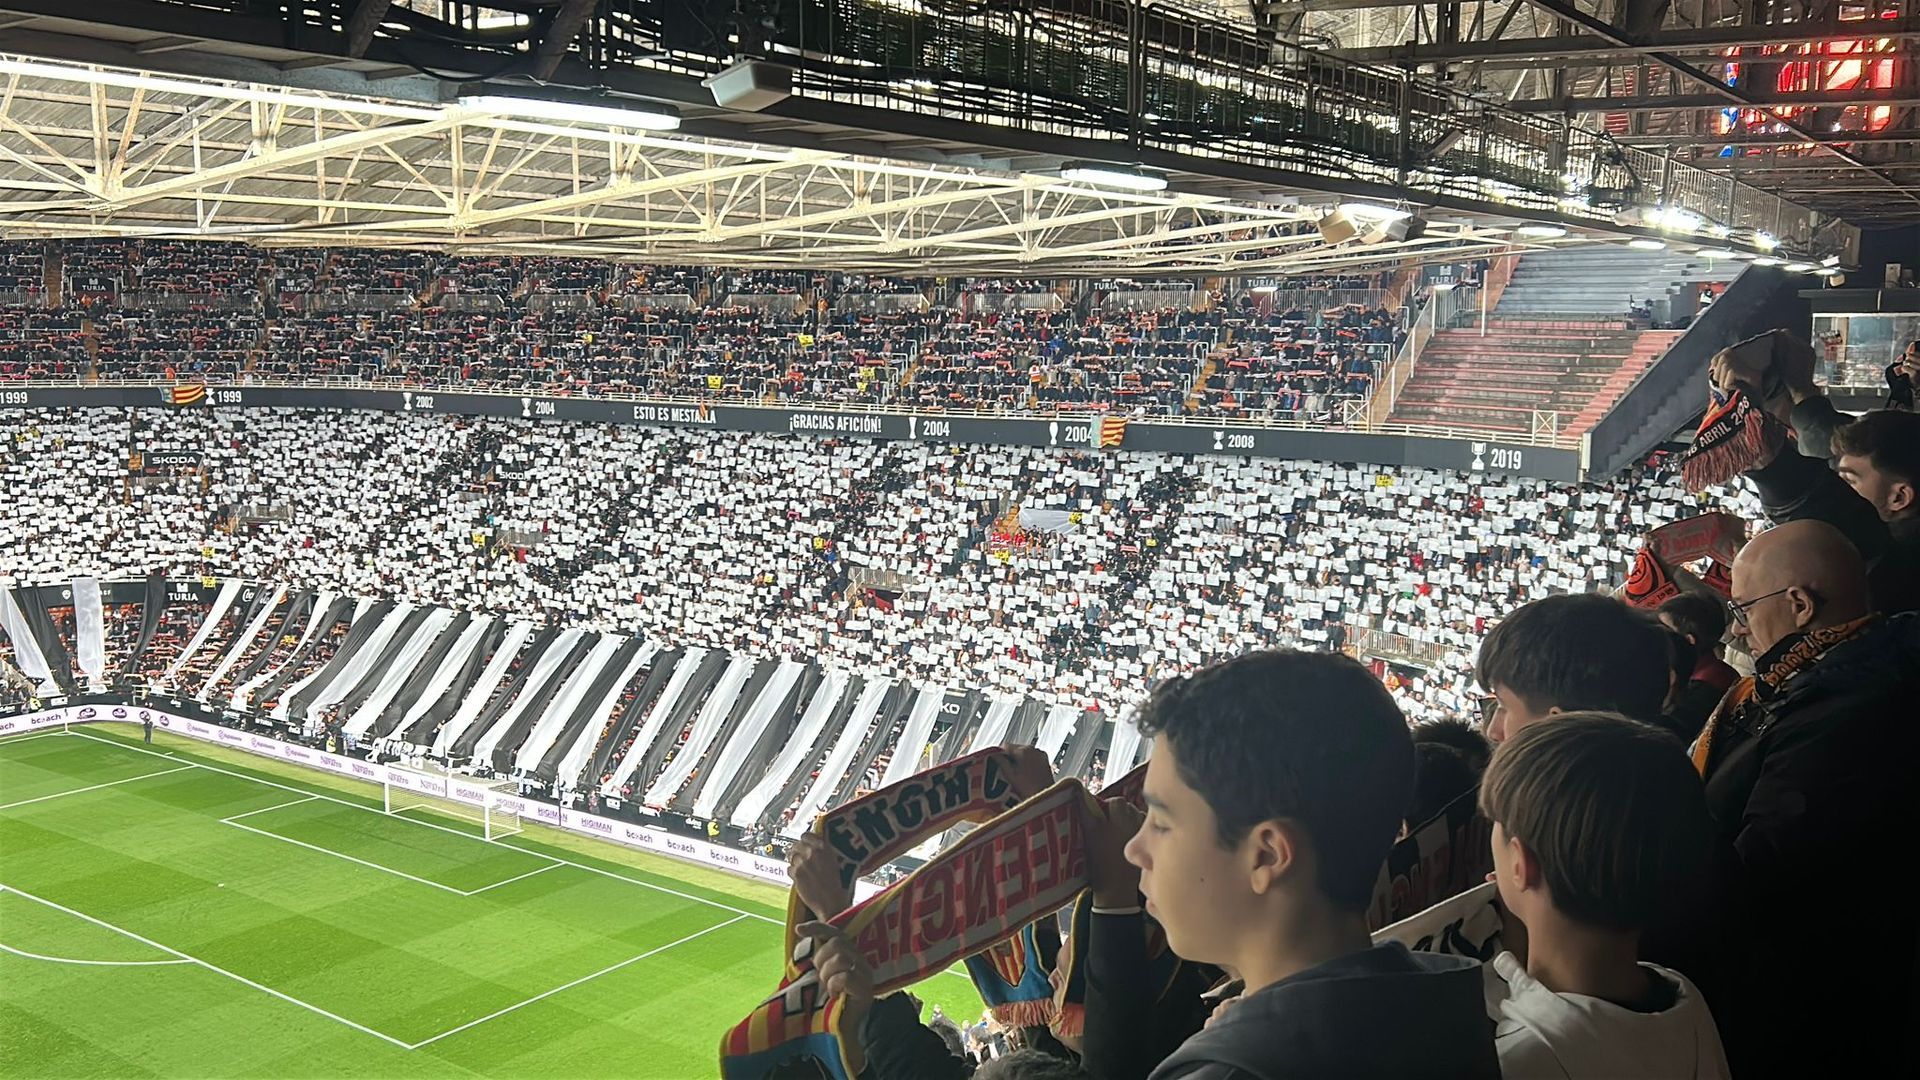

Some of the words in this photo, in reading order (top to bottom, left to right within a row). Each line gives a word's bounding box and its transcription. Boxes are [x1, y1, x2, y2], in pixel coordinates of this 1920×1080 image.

[1094, 282, 1118, 290] TURIA
[1247, 279, 1275, 287] TURIA
[0, 391, 28, 404] 1999
[217, 391, 242, 403] 1999
[416, 396, 434, 409] 2002
[535, 401, 555, 415] 2004
[633, 405, 655, 420] ESTO
[657, 407, 669, 421] ES
[789, 413, 835, 431] ¡GRACIAS
[923, 420, 950, 436] 2004
[1699, 421, 1732, 447] ABRIL
[1228, 433, 1255, 449] 2008
[152, 454, 196, 465] SKODA
[1490, 447, 1523, 470] 2019
[499, 471, 525, 480] SKOD
[168, 593, 198, 601] TURIA
[827, 760, 974, 888] ENGIN
